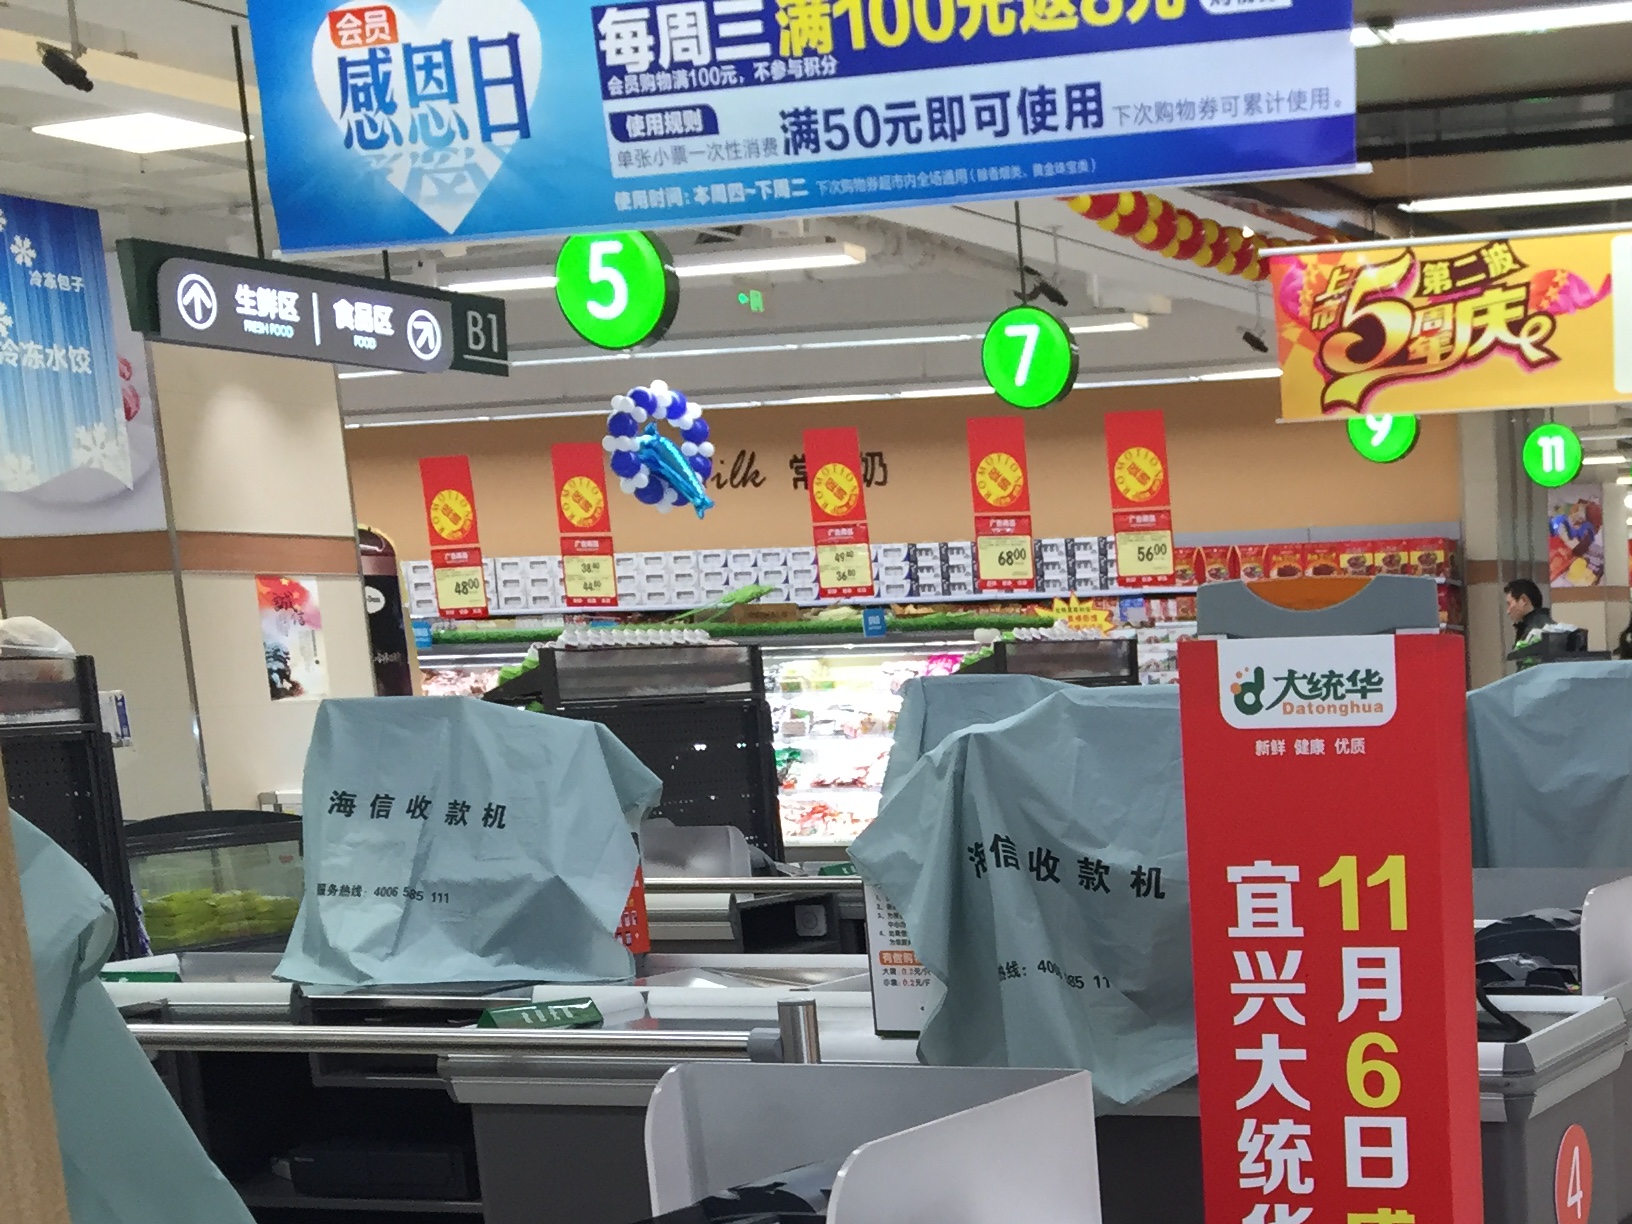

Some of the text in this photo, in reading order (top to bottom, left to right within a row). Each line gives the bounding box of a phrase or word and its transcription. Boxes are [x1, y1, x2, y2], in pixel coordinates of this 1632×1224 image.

[336, 10, 391, 45] 会员
[337, 32, 531, 150] 感恩日
[625, 108, 704, 139] 使用规则
[779, 82, 1105, 155] 满50元即可使用
[28, 270, 84, 293] 冷冻包子
[586, 240, 628, 320] 5
[1421, 241, 1517, 296] 第二波
[234, 283, 301, 322] 生鲜区
[332, 298, 395, 336] 食品区
[466, 310, 499, 352] B1
[0, 338, 92, 375] 冷冻水饺
[1004, 324, 1040, 387] 7
[711, 449, 767, 490] ilk
[1537, 436, 1566, 473] 11
[1265, 668, 1384, 711] 大统华
[1281, 701, 1384, 717] Datonghua
[1255, 737, 1366, 757] 新鲜 健康 优质
[328, 789, 507, 829] 海信收款机
[1566, 1145, 1584, 1219] 4
